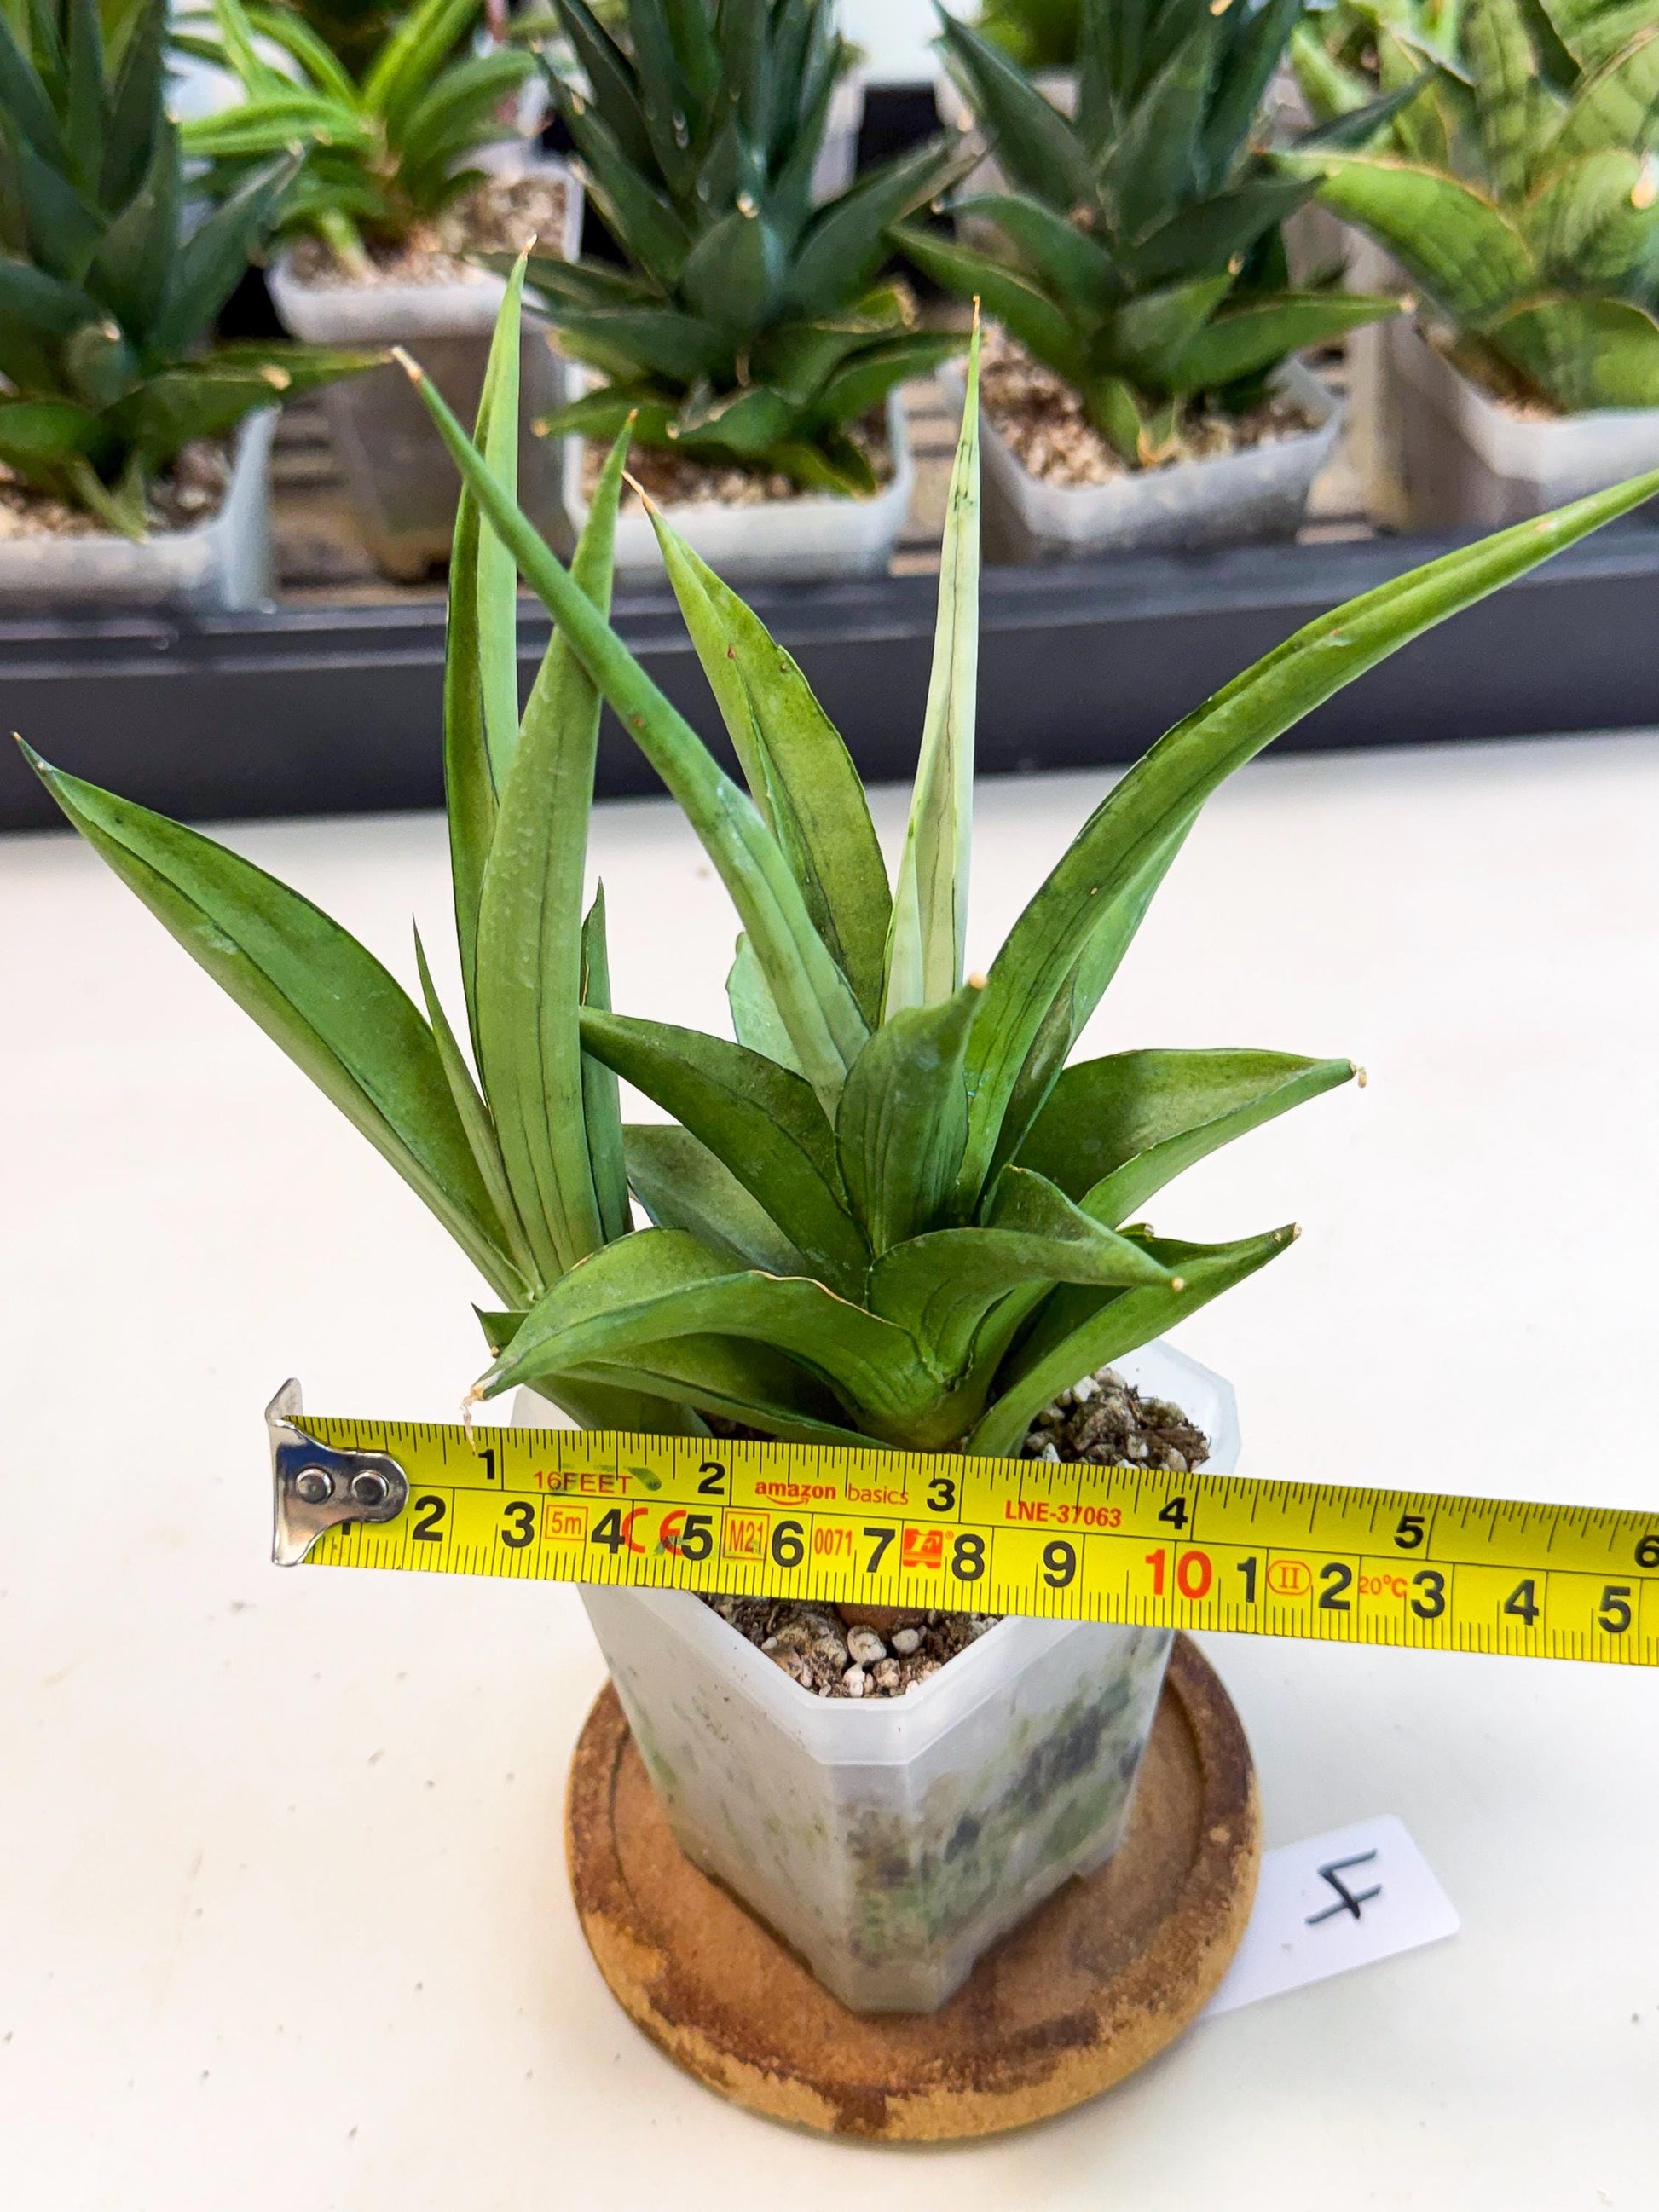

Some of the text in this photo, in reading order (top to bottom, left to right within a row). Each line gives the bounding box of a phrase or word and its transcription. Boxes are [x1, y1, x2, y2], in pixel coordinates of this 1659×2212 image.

[477, 1449, 495, 1480] 1
[534, 1470, 633, 1495] 16FEET
[698, 1462, 725, 1495] 2
[754, 1481, 909, 1505] amazon basics
[926, 1478, 956, 1512] 3
[1005, 1500, 1122, 1528] LNE-37063
[1158, 1497, 1188, 1530] 4
[412, 1495, 447, 1541] 2
[501, 1501, 535, 1548] 3
[552, 1511, 581, 1535] 5m
[591, 1509, 626, 1554] 4
[681, 1514, 713, 1561] 5
[730, 1520, 764, 1554] M21
[1394, 1515, 1425, 1549] 5
[772, 1521, 805, 1568] 6
[814, 1528, 853, 1556] 0071
[863, 1528, 896, 1573] 7
[951, 1533, 985, 1581] 8
[1043, 1540, 1077, 1588] 9
[1634, 1534, 1659, 1568] 6
[1145, 1549, 1212, 1598] 10
[1236, 1556, 1257, 1603] 1
[1280, 1567, 1300, 1589] II
[1319, 1562, 1352, 1610] 2
[1411, 1570, 1446, 1619] 3
[1503, 1579, 1540, 1626] 4
[1598, 1585, 1632, 1633] 5
